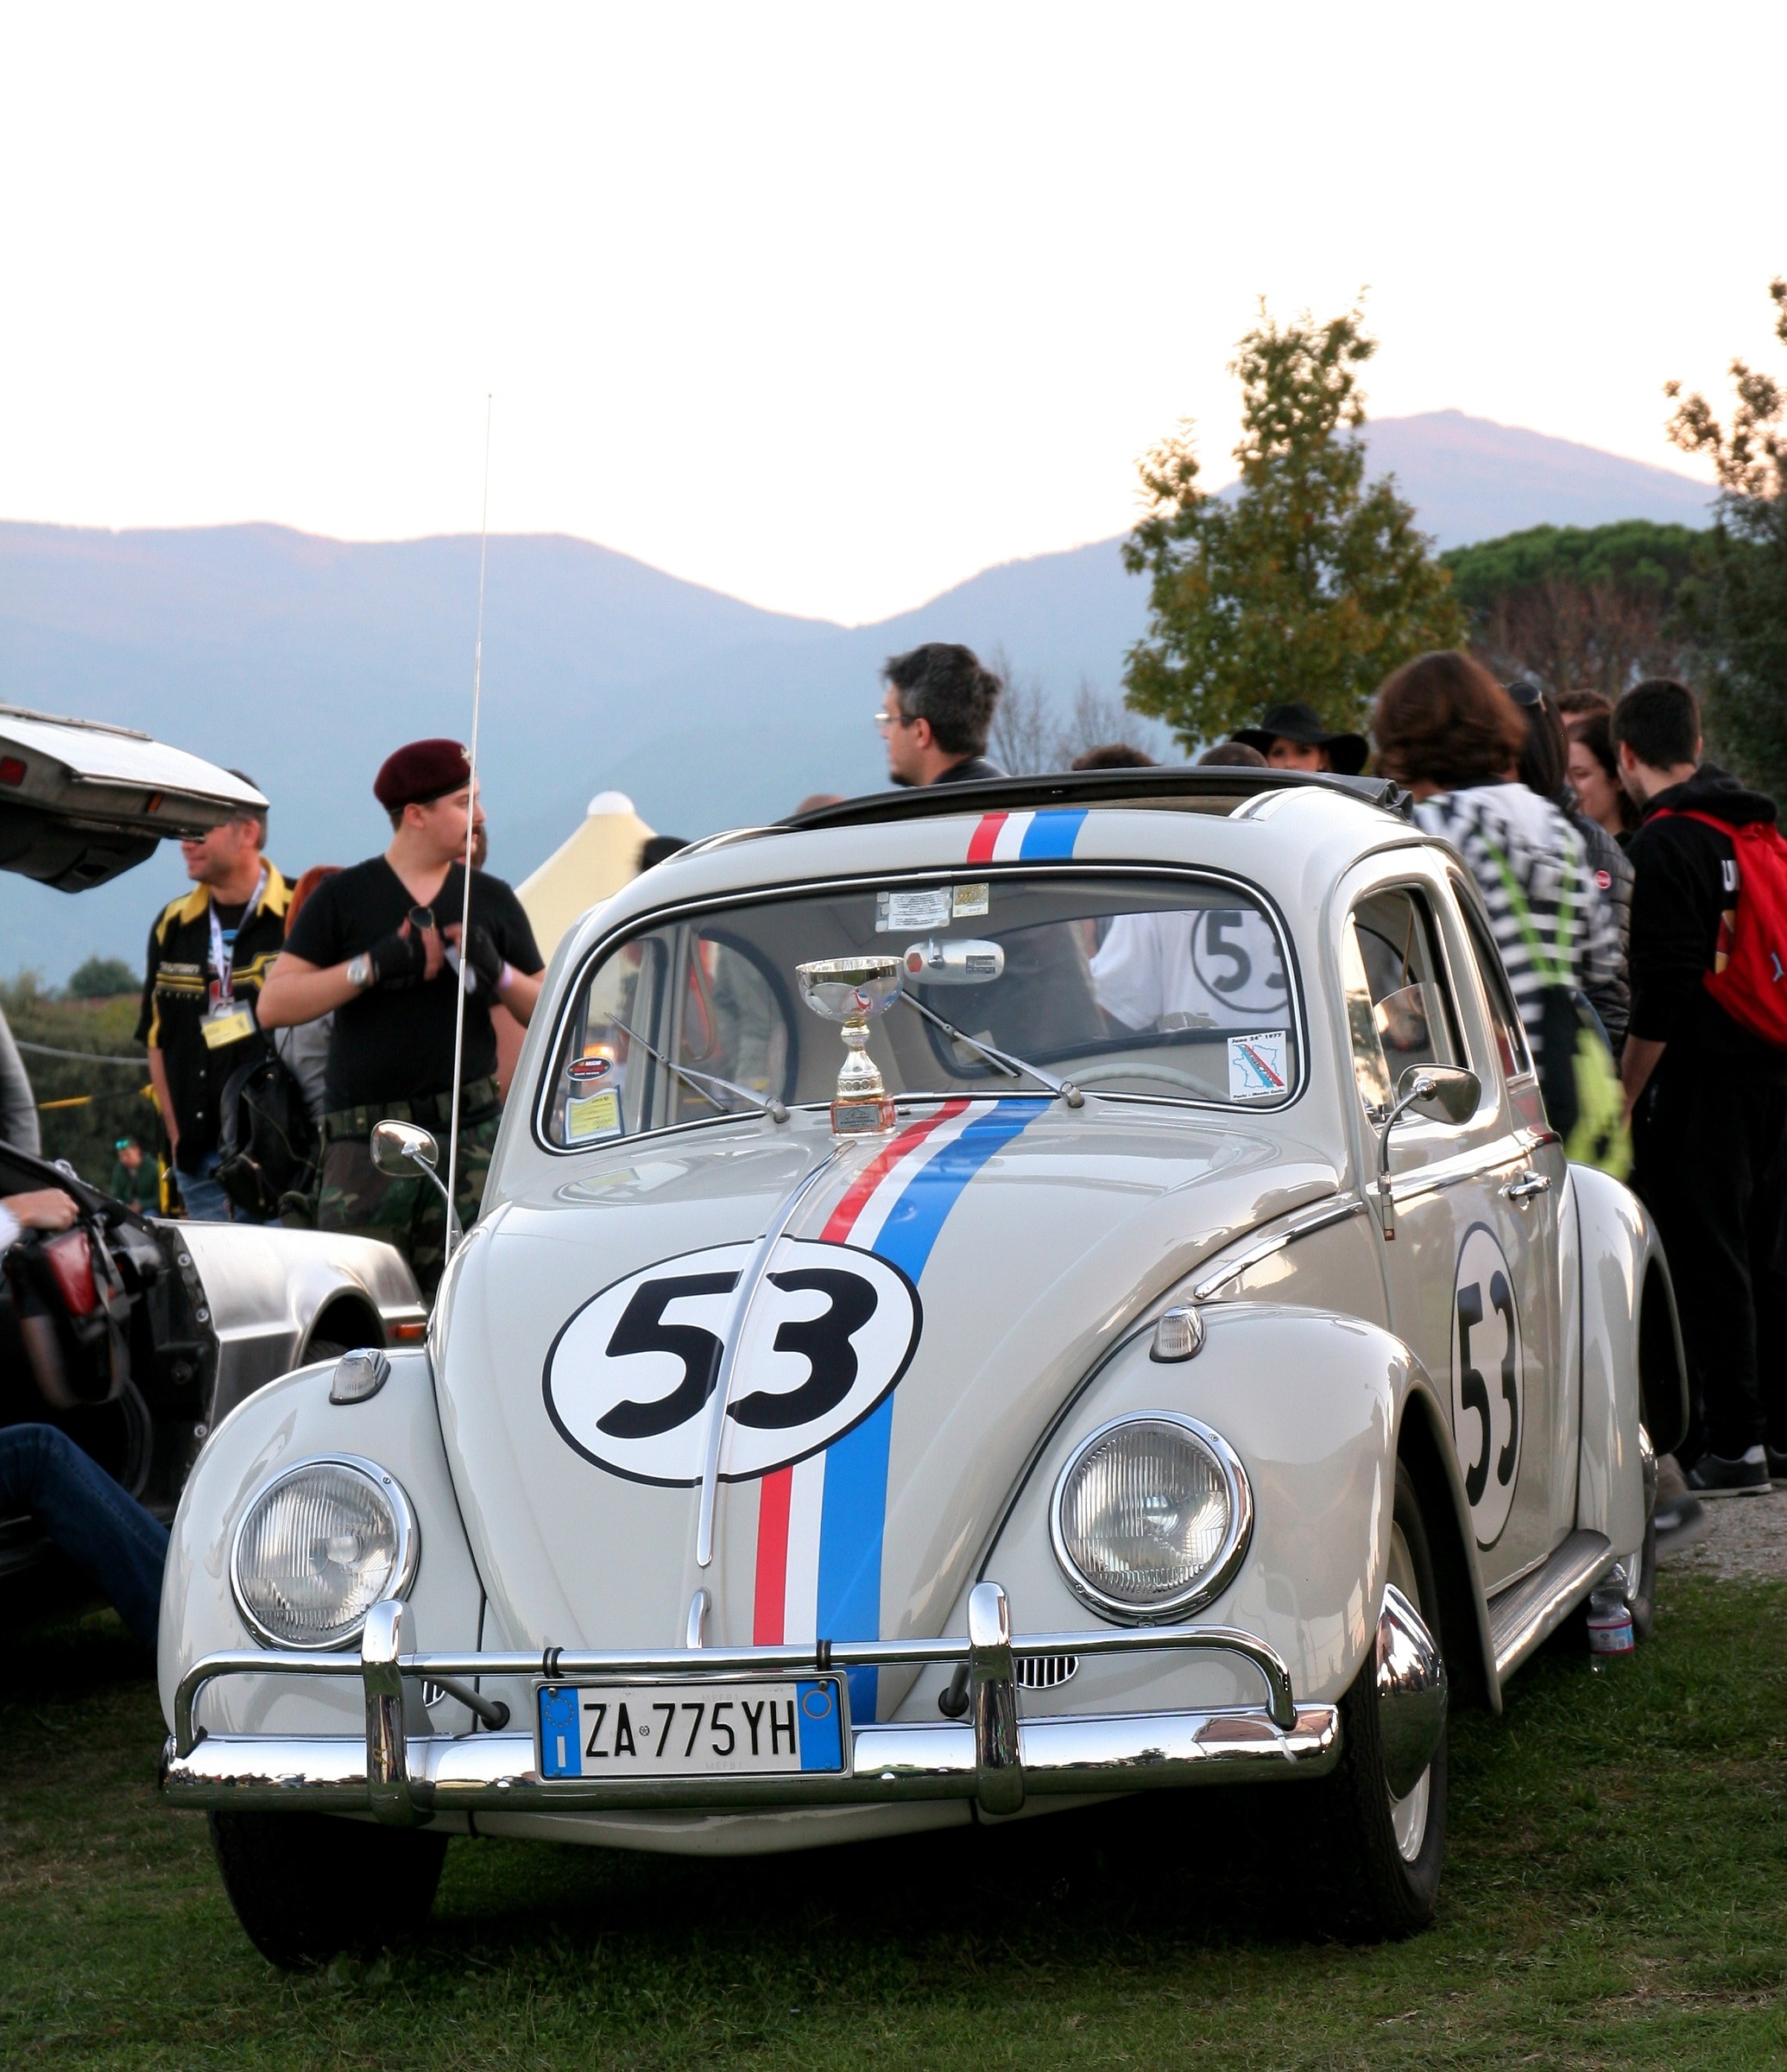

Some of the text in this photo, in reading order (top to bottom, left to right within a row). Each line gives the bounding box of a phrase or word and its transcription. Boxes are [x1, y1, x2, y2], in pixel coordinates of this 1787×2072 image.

[1207, 911, 1287, 993] 5
[595, 1268, 879, 1440] 53
[1457, 1270, 1519, 1507] 53
[584, 1700, 797, 1758] ZA 775YH
